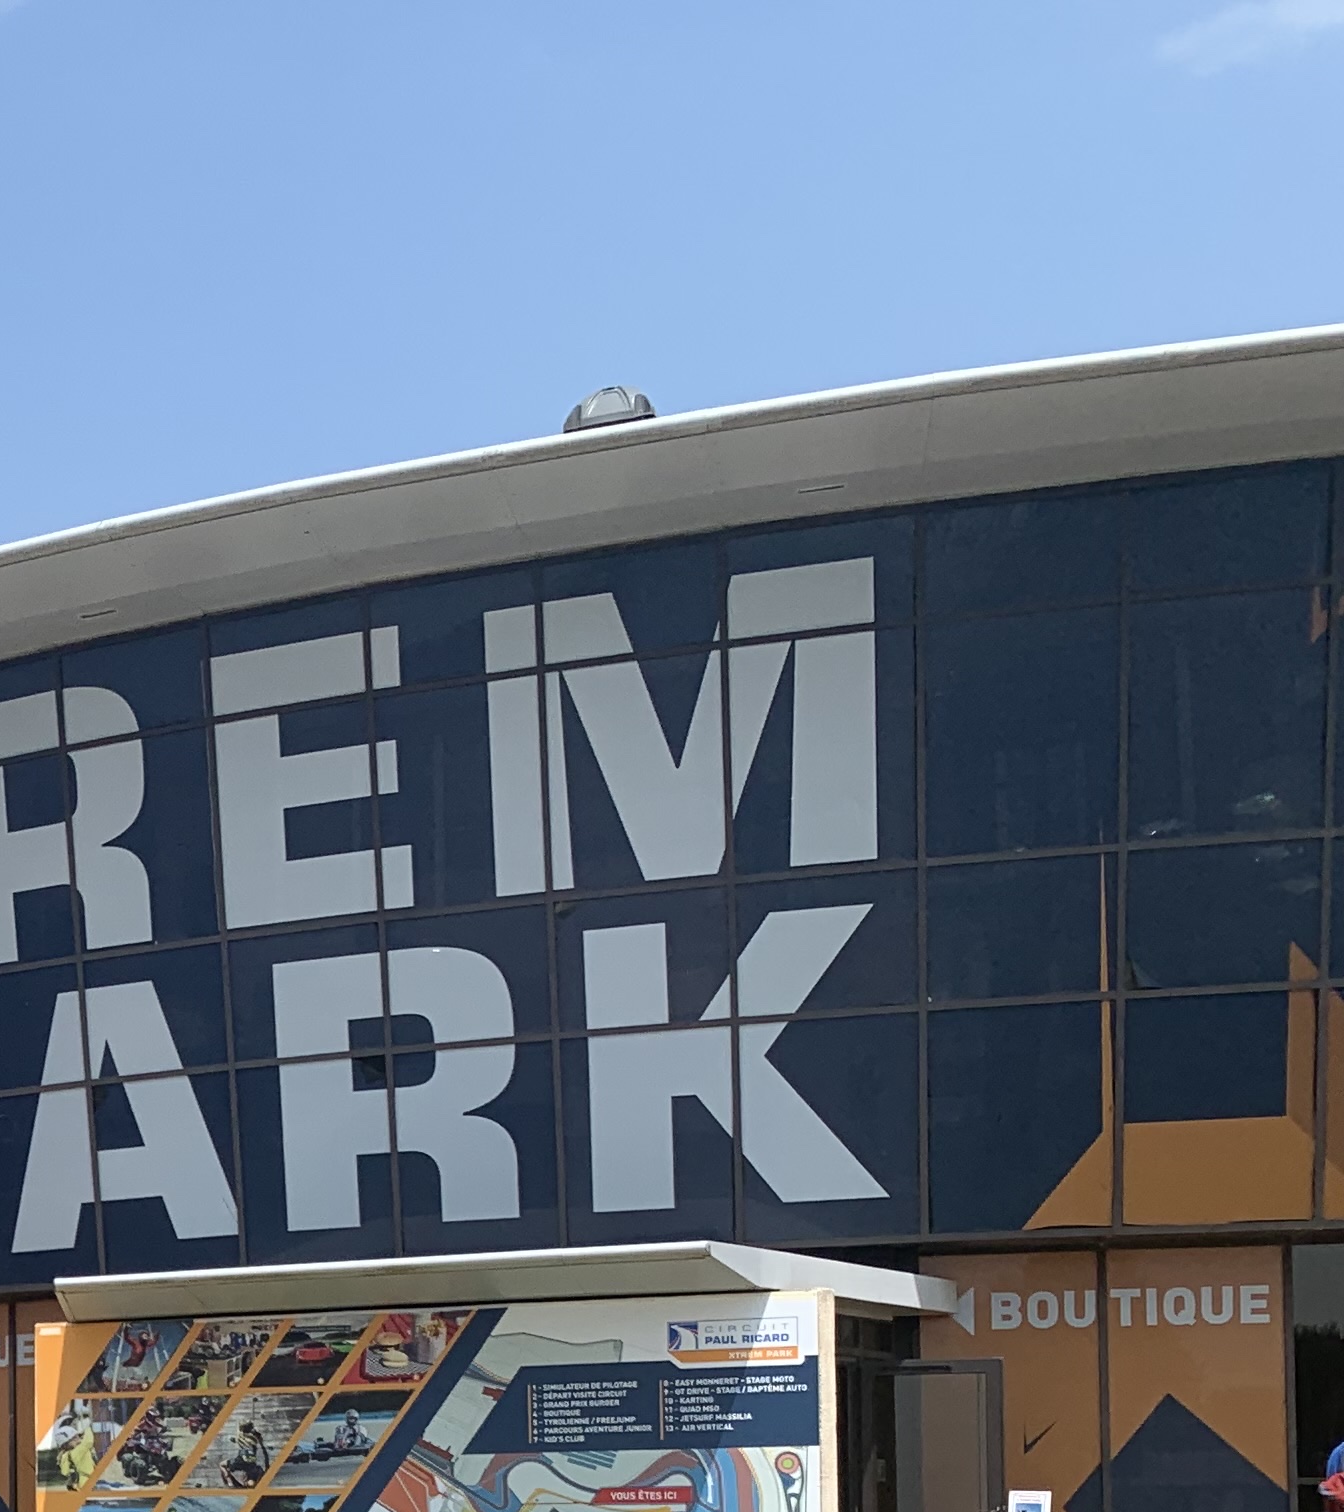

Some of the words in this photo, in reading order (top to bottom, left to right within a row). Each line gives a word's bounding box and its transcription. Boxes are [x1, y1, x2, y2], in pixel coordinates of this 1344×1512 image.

[991, 1284, 1271, 1331] BOUTIQUE
[705, 1322, 789, 1334] CIRCUIT
[705, 1334, 737, 1345] PAUL
[742, 1333, 790, 1344] RICARD
[728, 1350, 763, 1360] XTREM
[766, 1349, 793, 1358] PARK
[746, 1376, 771, 1384] STAGE
[772, 1375, 795, 1384] MOTO
[591, 1381, 601, 1390] DE
[603, 1380, 638, 1389] PILOTAGE
[716, 1386, 741, 1394] STAGE
[786, 1384, 808, 1392] AUTO
[598, 1390, 627, 1398] CIRCUIT
[571, 1400, 588, 1408] PRIX
[611, 1491, 636, 1501] VOUS
[638, 1489, 662, 1500] ÊTES
[664, 1491, 677, 1500] ICI
